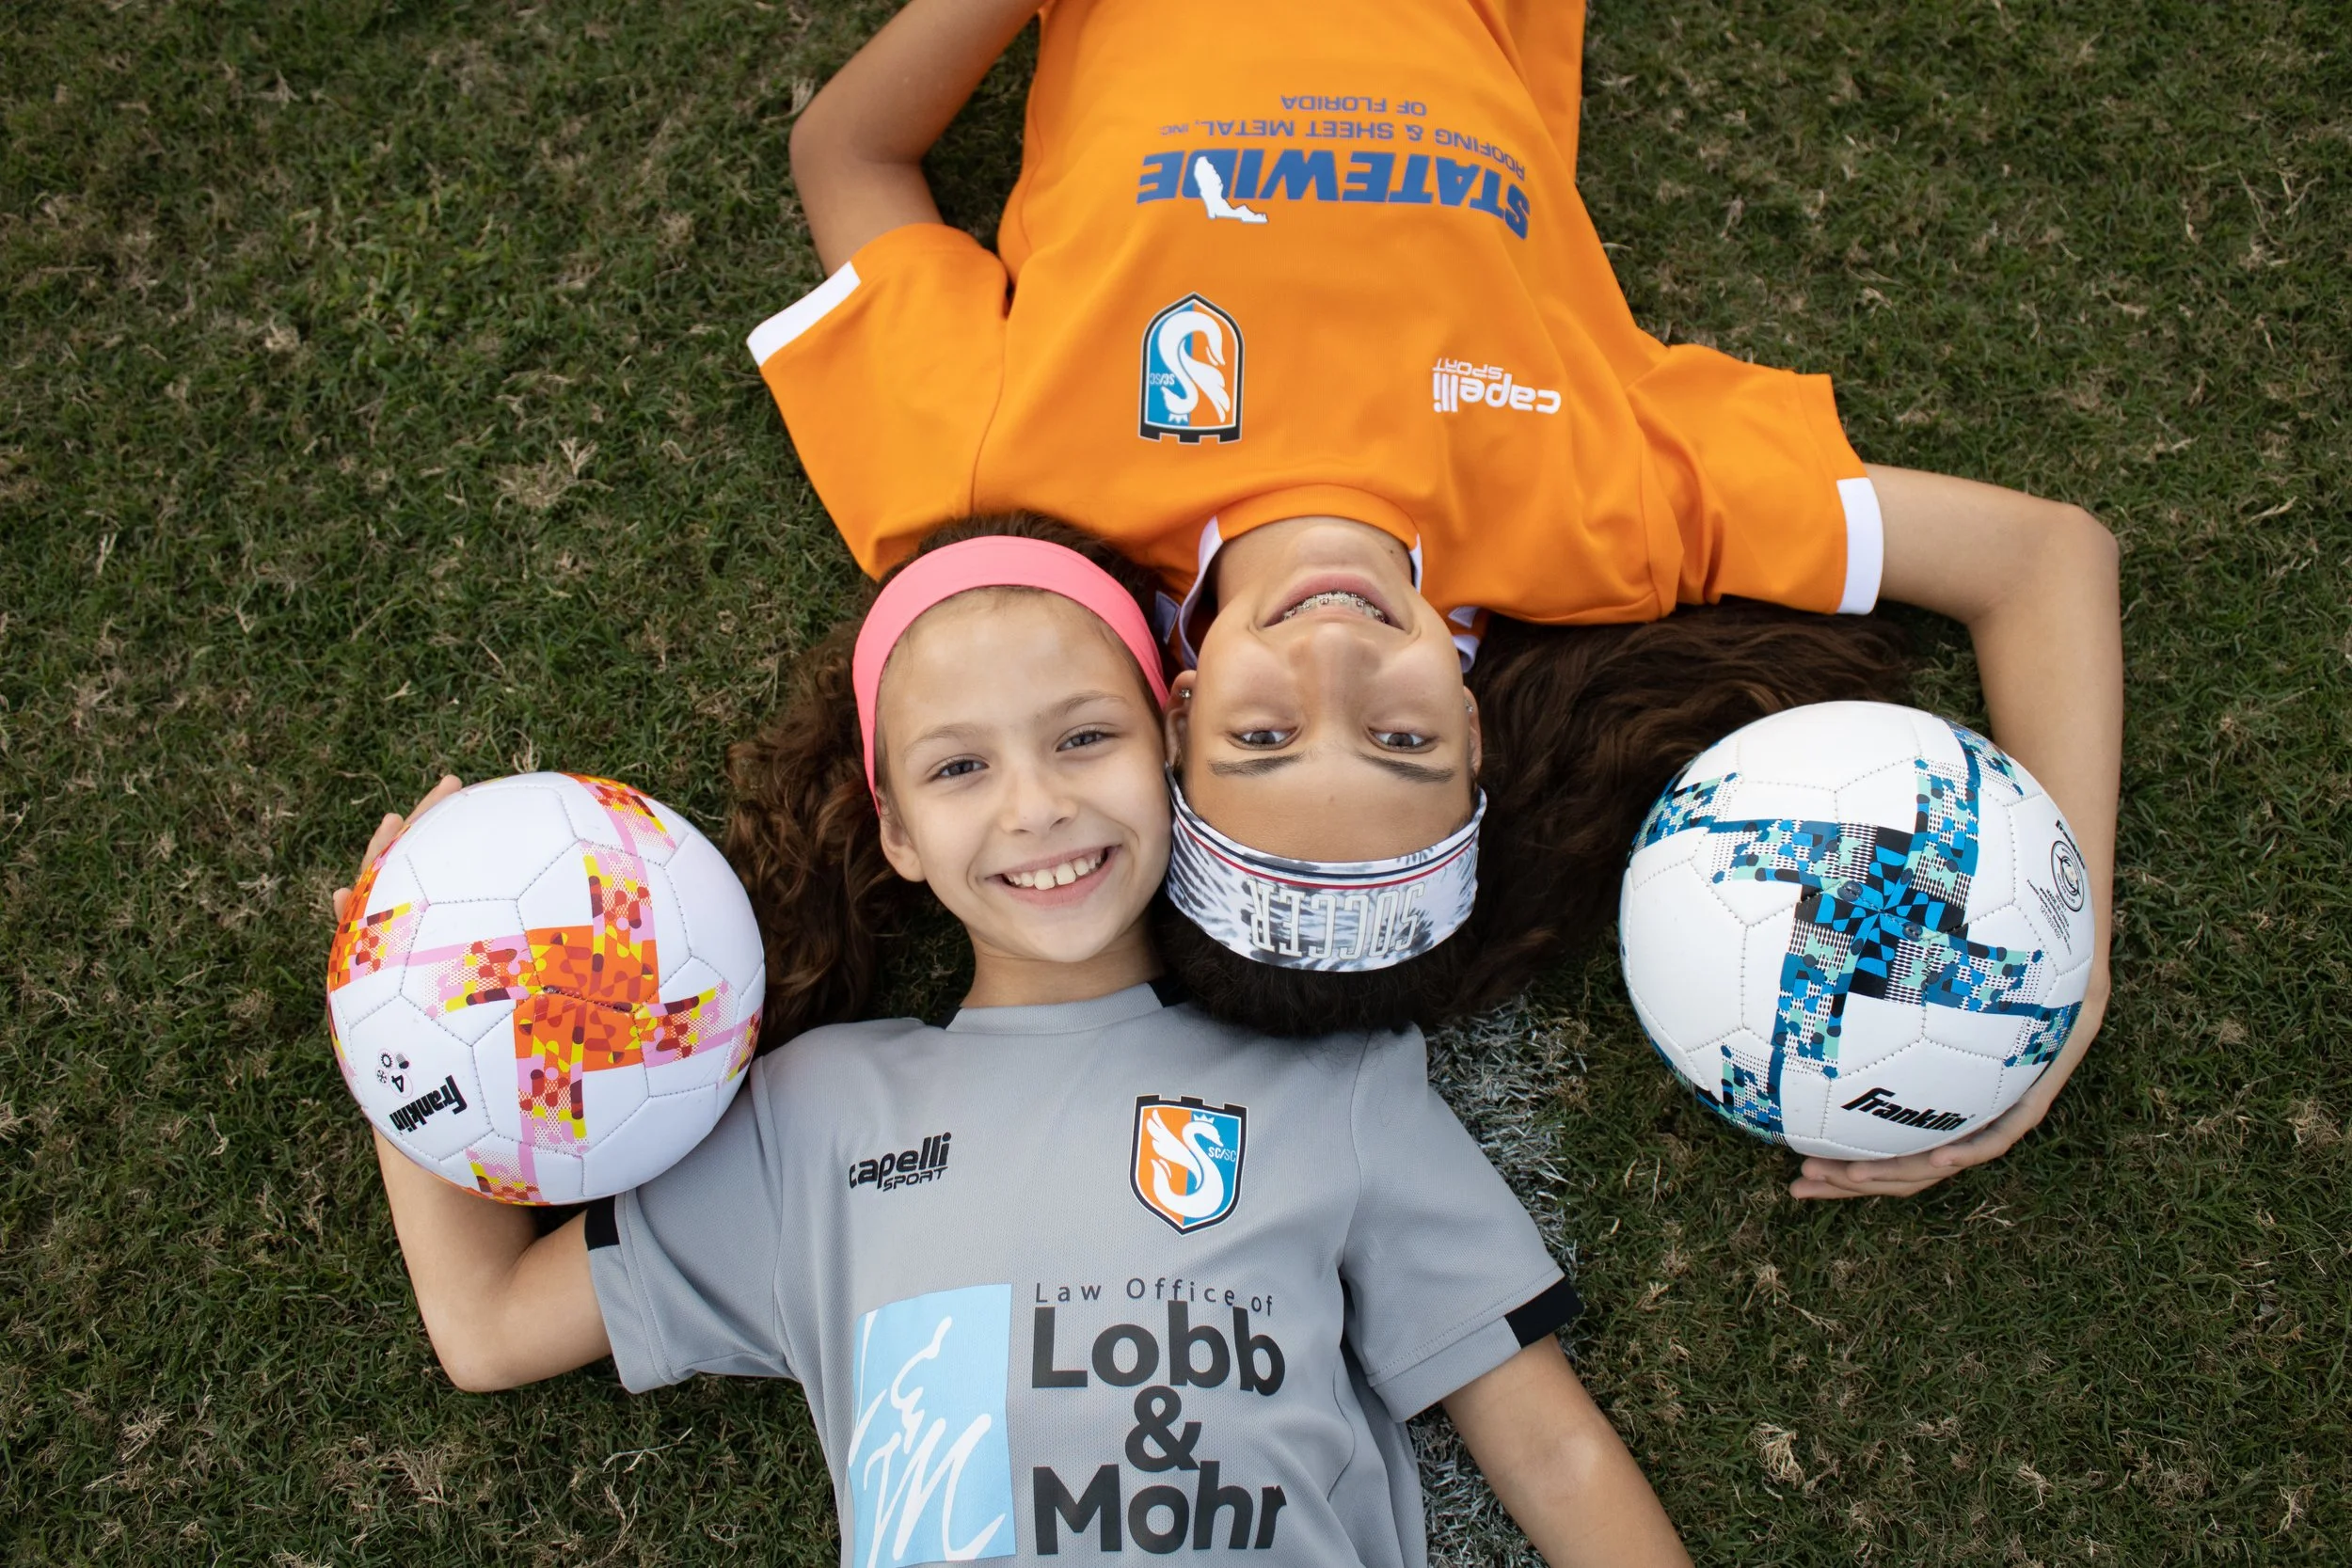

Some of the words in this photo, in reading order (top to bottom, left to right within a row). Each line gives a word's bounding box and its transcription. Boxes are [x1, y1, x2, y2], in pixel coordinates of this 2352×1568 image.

[1280, 95, 1387, 112] FLORIDA
[1396, 100, 1427, 117] OF
[1195, 119, 1294, 136] METAL,
[1305, 120, 1393, 139] SHEET
[1405, 123, 1423, 141] &
[1435, 128, 1525, 182] ROOFING
[1136, 149, 1531, 240] STATEWIDE
[1432, 357, 1504, 380] SPORT
[1433, 372, 1562, 414] capelli
[1247, 879, 1425, 960] SOCCER
[389, 1074, 468, 1132] Franklin
[390, 1074, 405, 1093] 4
[1840, 1087, 1968, 1132] Franklin
[849, 1132, 952, 1189] capelli
[1208, 1146, 1237, 1163] SC/SC
[882, 1166, 949, 1193] SPORT
[1035, 1281, 1103, 1304] Law
[1126, 1277, 1236, 1307] Office
[1251, 1294, 1274, 1317] of
[1032, 1300, 1286, 1397] Lobb
[1124, 1385, 1202, 1473] &
[1032, 1460, 1288, 1556] Mohr
